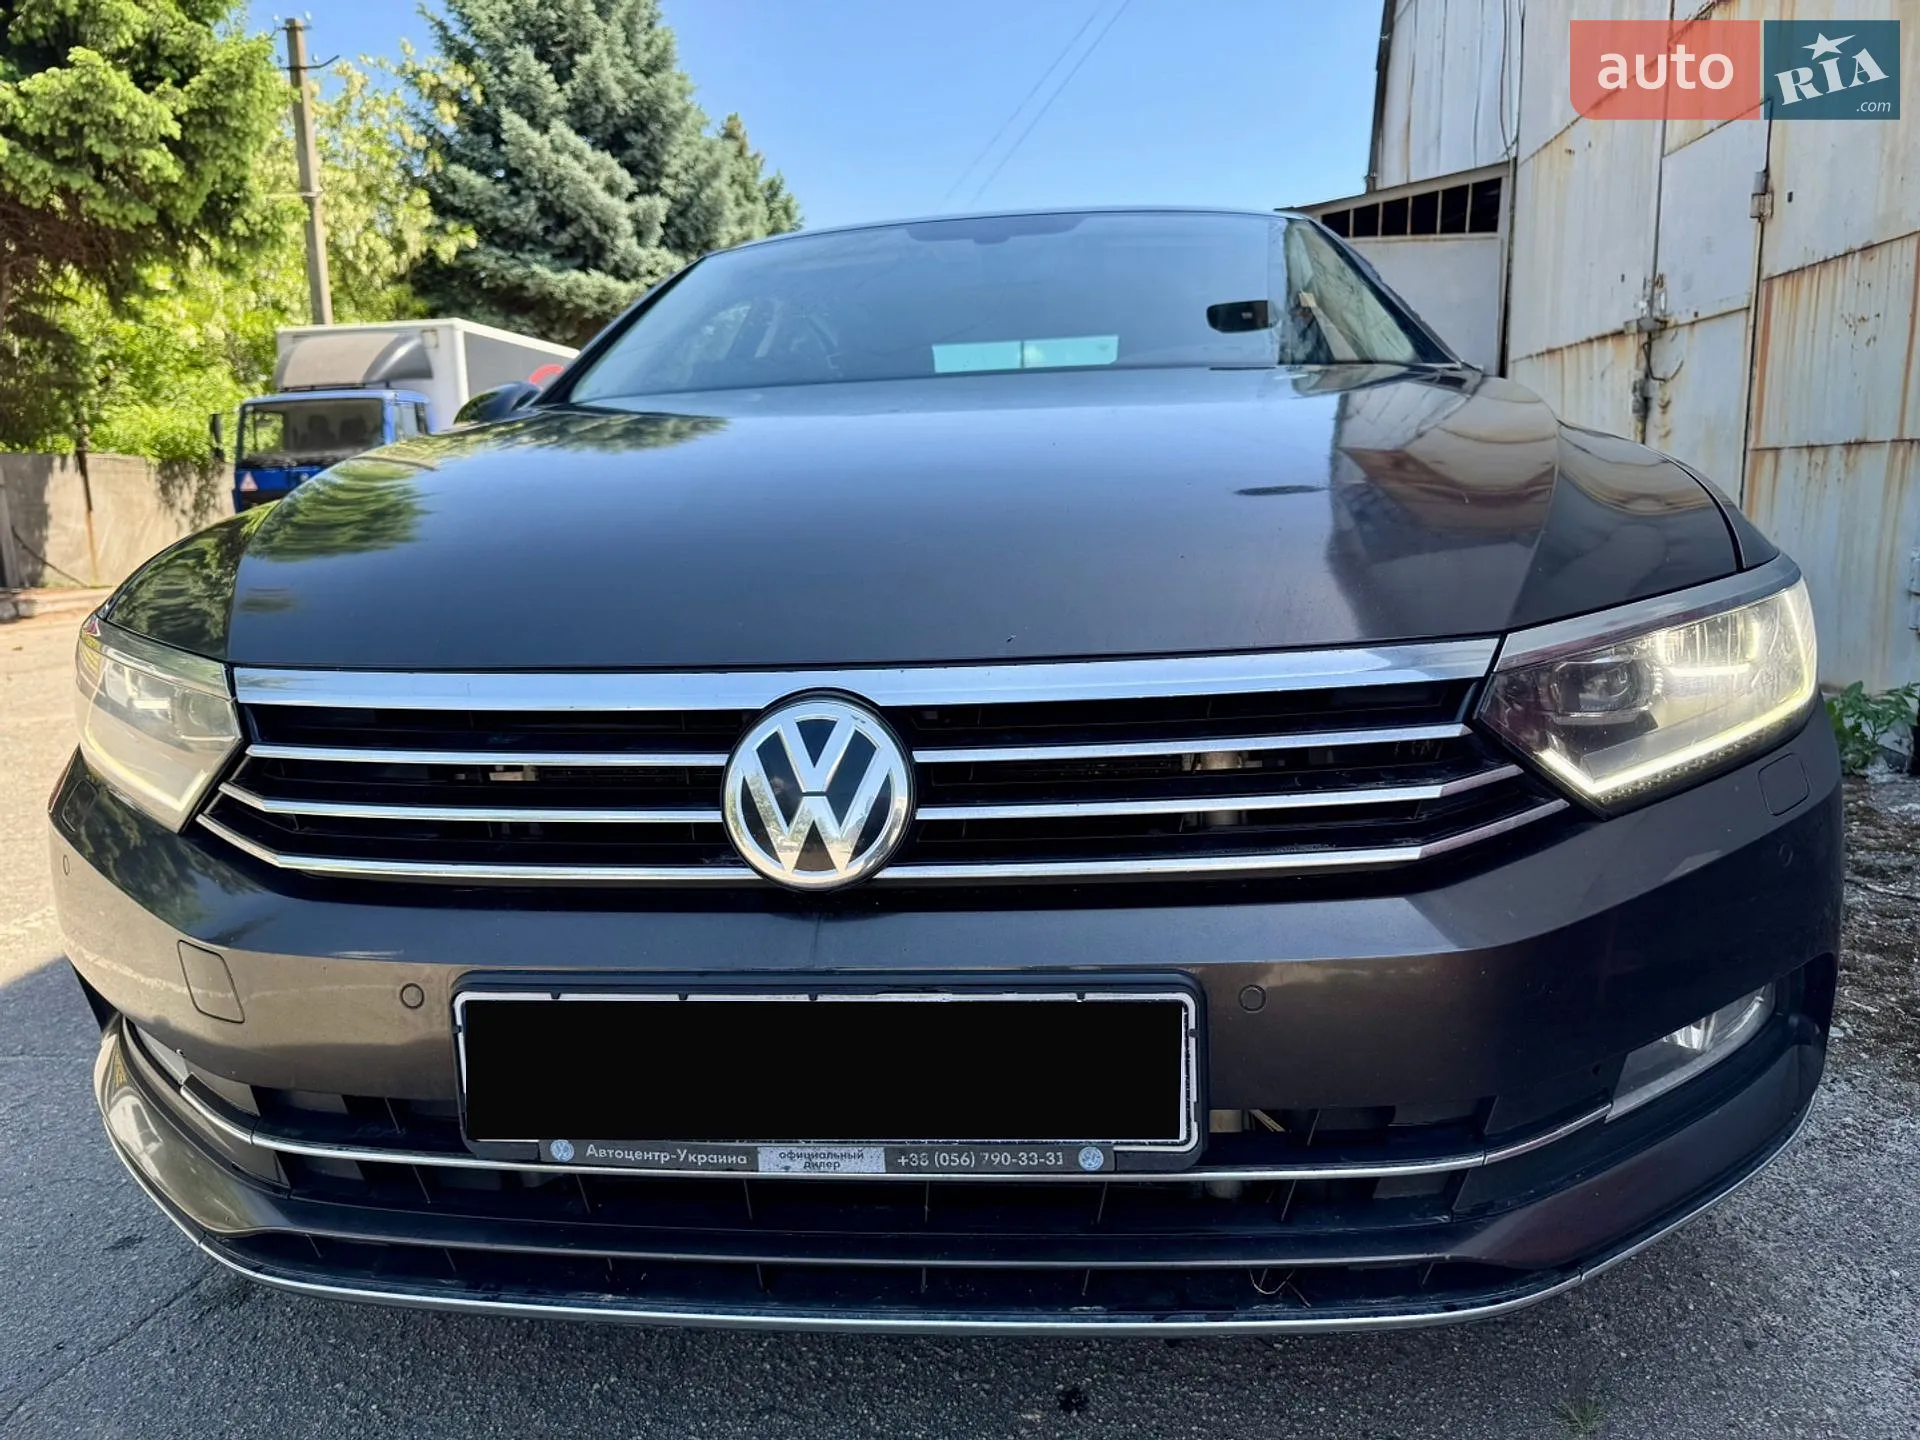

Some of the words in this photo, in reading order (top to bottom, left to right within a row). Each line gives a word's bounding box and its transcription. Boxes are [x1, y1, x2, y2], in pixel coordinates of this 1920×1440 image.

[585, 1143, 748, 1165] Автоцентр-Украина
[779, 1149, 864, 1161] официальный
[934, 1151, 976, 1168] (056)
[980, 1151, 1064, 1166] 790-33-31
